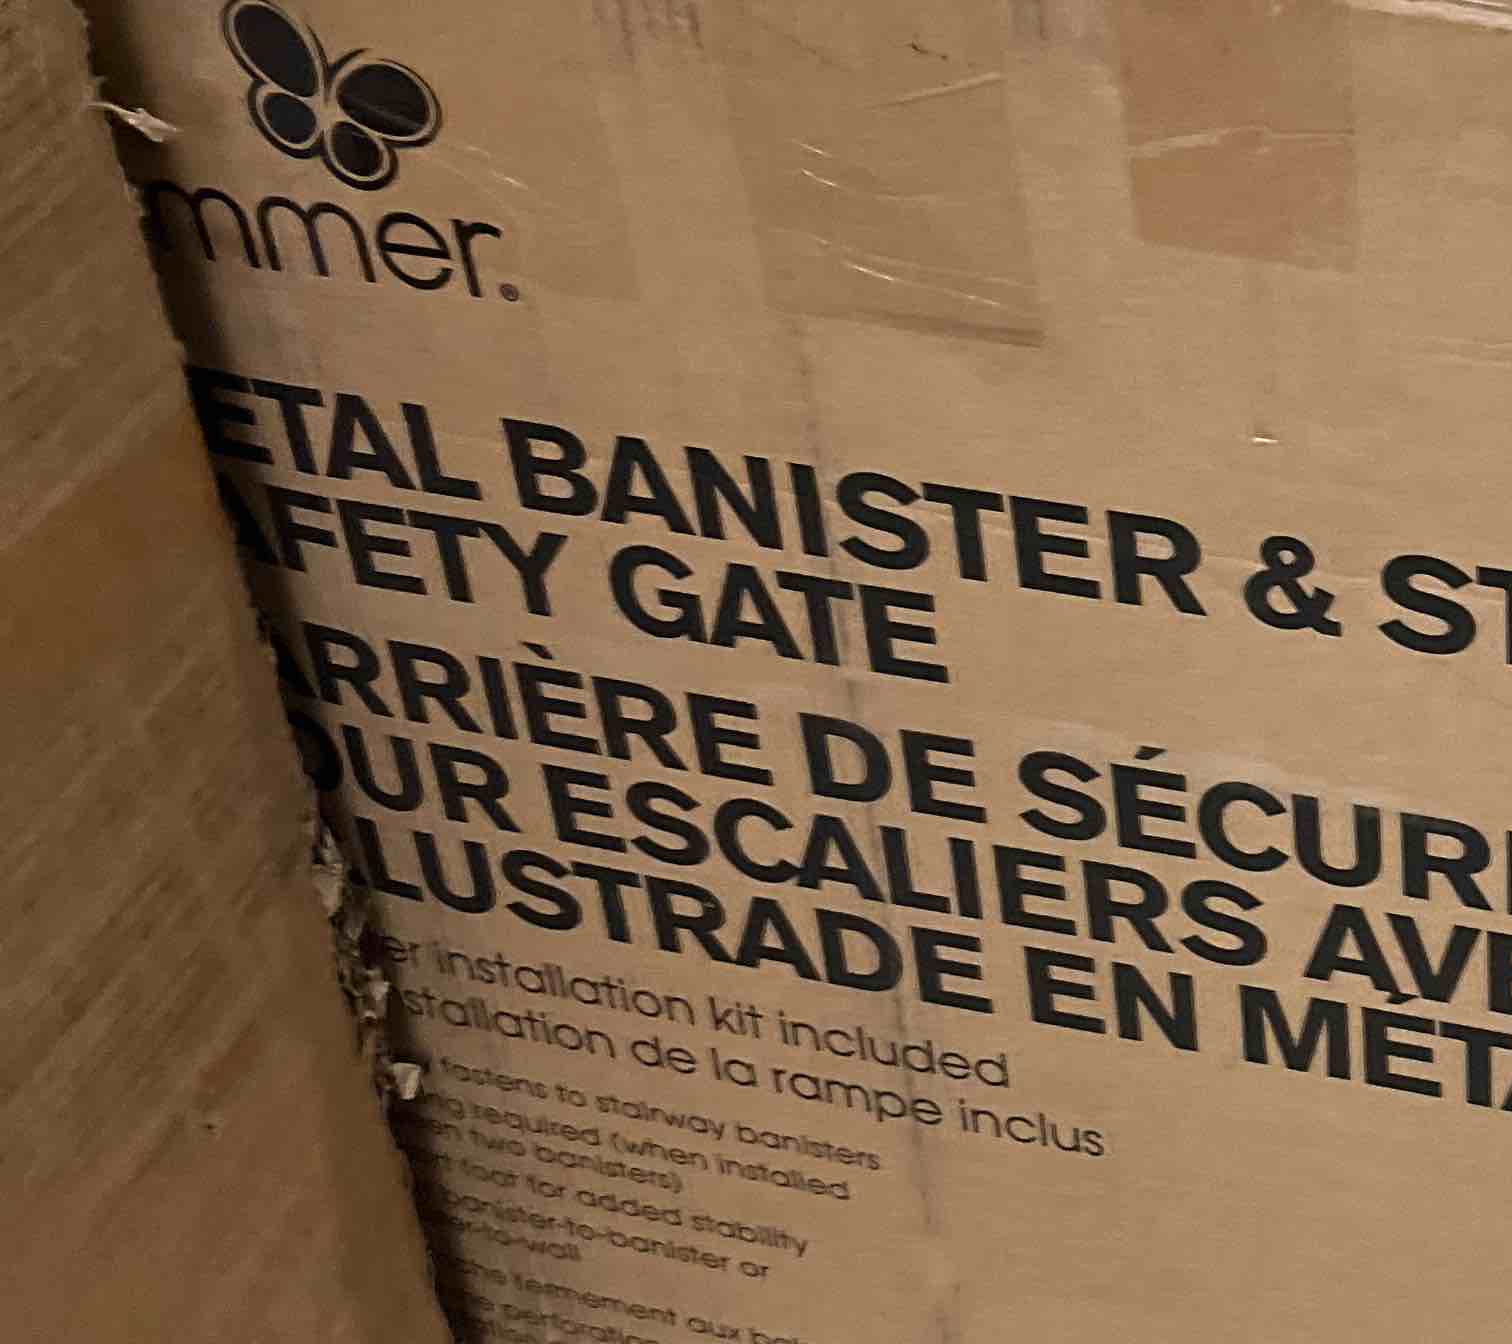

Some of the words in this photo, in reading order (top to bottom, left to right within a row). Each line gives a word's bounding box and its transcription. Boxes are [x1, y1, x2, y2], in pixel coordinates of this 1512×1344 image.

[186, 365, 478, 502] ETAL
[501, 417, 1206, 617] BANISTER
[1242, 535, 1344, 639] &
[219, 471, 567, 617] AFETY
[609, 543, 948, 685] GATE
[800, 711, 986, 825] DE
[289, 709, 522, 834] OUR
[542, 761, 1269, 969] ESCALIERS
[347, 817, 994, 1014] LUSTRADE
[1022, 943, 1200, 1053] EN
[384, 934, 420, 967] er
[436, 942, 695, 1027] installation
[708, 995, 762, 1039] kit
[778, 1011, 1009, 1088] included
[403, 985, 615, 1058] stallation
[631, 1036, 697, 1074] de
[711, 1047, 757, 1088] la
[769, 1067, 943, 1125] rampe
[958, 1098, 1104, 1156] inclus
[554, 1082, 588, 1108] to
[596, 1093, 726, 1141] stairway
[735, 1120, 881, 1171] banisters
[526, 1173, 568, 1199] for
[577, 1187, 683, 1226] added
[692, 1212, 807, 1256] stability
[535, 1143, 683, 1194] banisters)
[611, 1132, 708, 1170] (when
[719, 1154, 850, 1200] installed
[738, 1261, 769, 1278] or
[687, 1316, 741, 1341] aux
